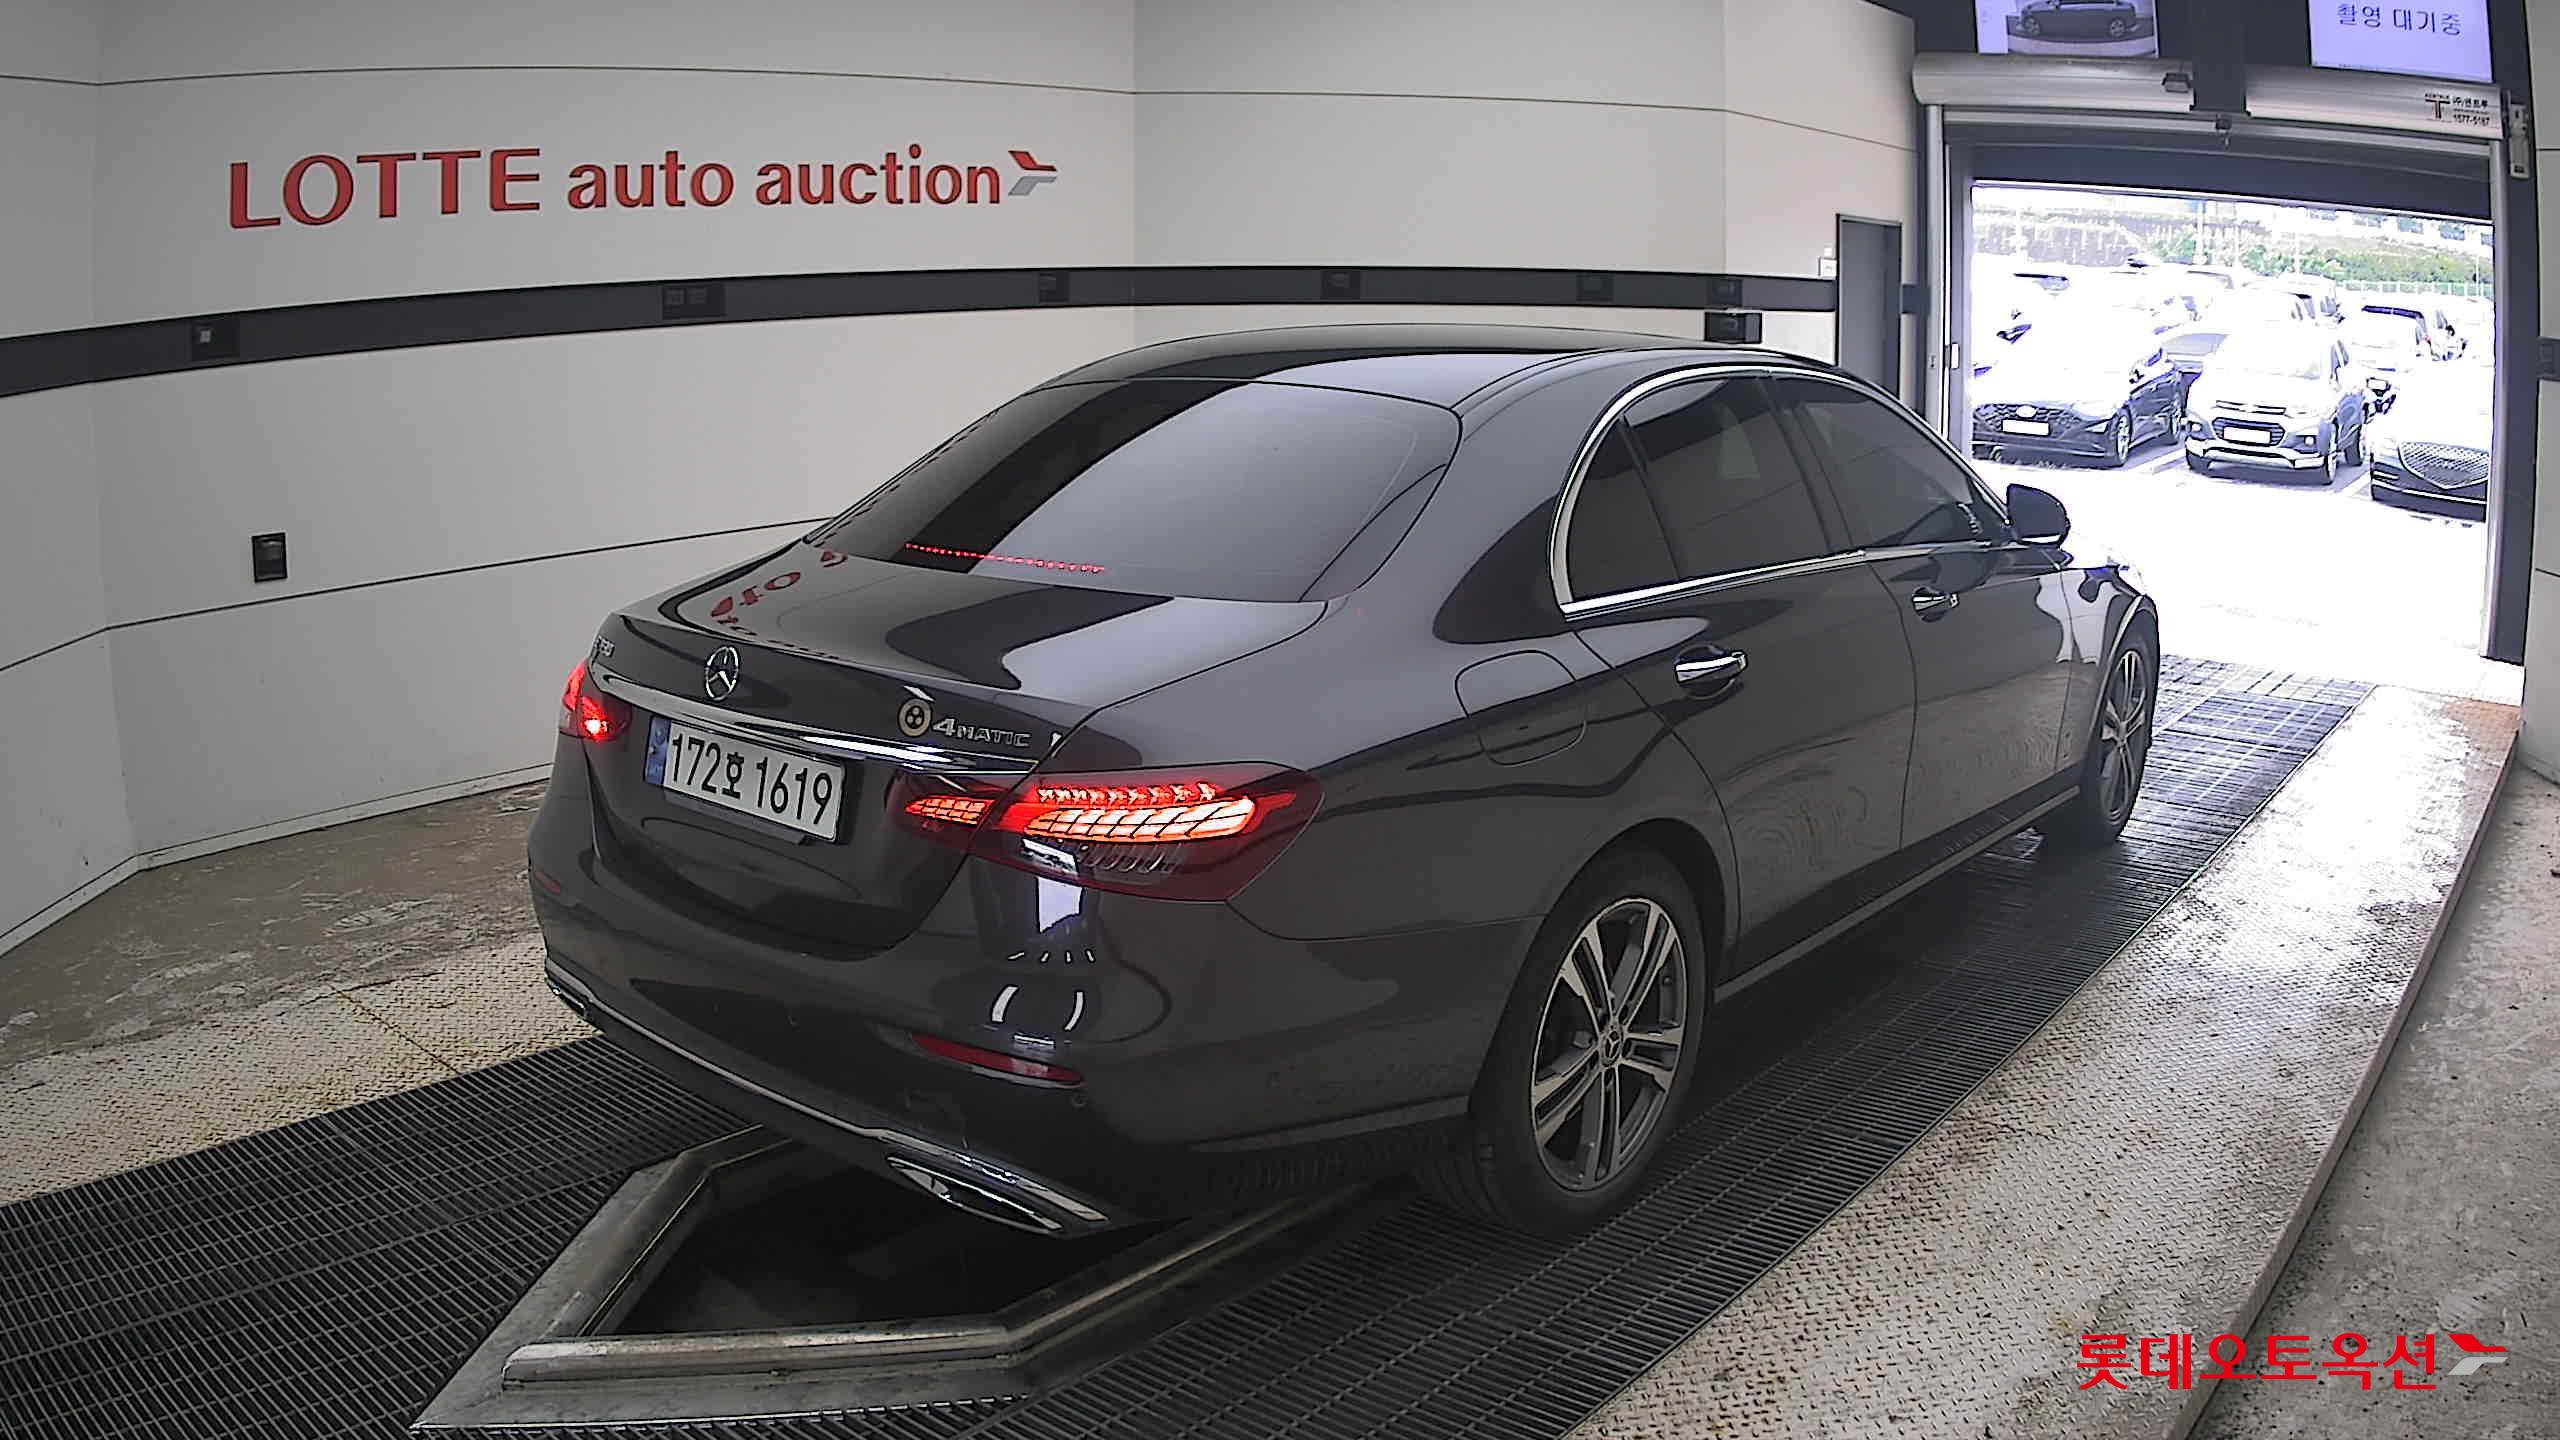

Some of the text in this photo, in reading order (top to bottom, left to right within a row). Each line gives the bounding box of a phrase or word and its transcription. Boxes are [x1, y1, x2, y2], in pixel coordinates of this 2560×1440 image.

[2337, 4, 2462, 36] 촬영 대기중
[229, 143, 1000, 229] LOTTE auto auction
[932, 718, 1032, 748] 4MATIC
[671, 733, 833, 825] 172호 1619
